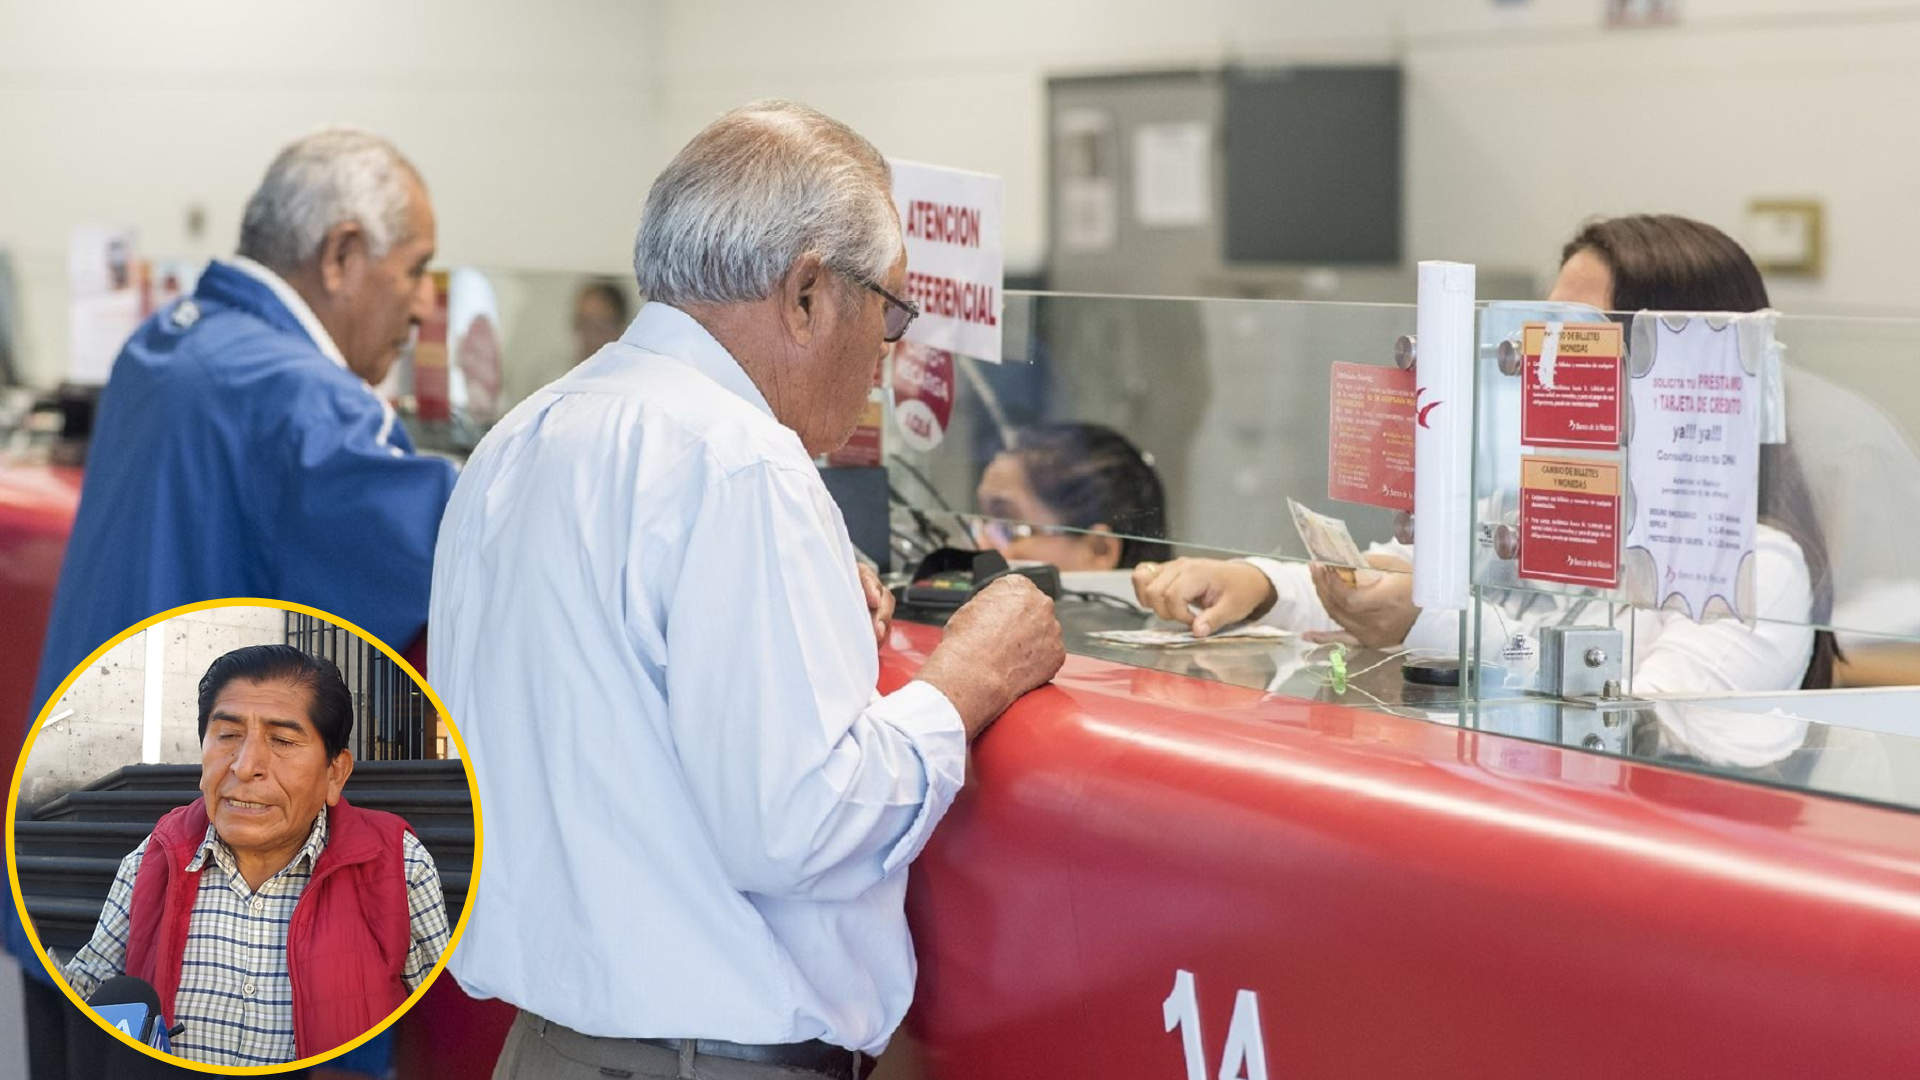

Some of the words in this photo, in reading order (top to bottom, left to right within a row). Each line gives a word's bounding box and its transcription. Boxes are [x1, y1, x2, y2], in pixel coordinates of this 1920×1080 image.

[907, 199, 980, 248] ATENCION
[1660, 394, 1694, 412] TARJETA
[1697, 396, 1708, 413] DE
[1657, 450, 1693, 462] Consulta
[1542, 466, 1564, 474] CAMBIO
[1565, 467, 1573, 476] DE
[1574, 468, 1599, 478] BILLETES
[1558, 479, 1587, 489] MONEDAS
